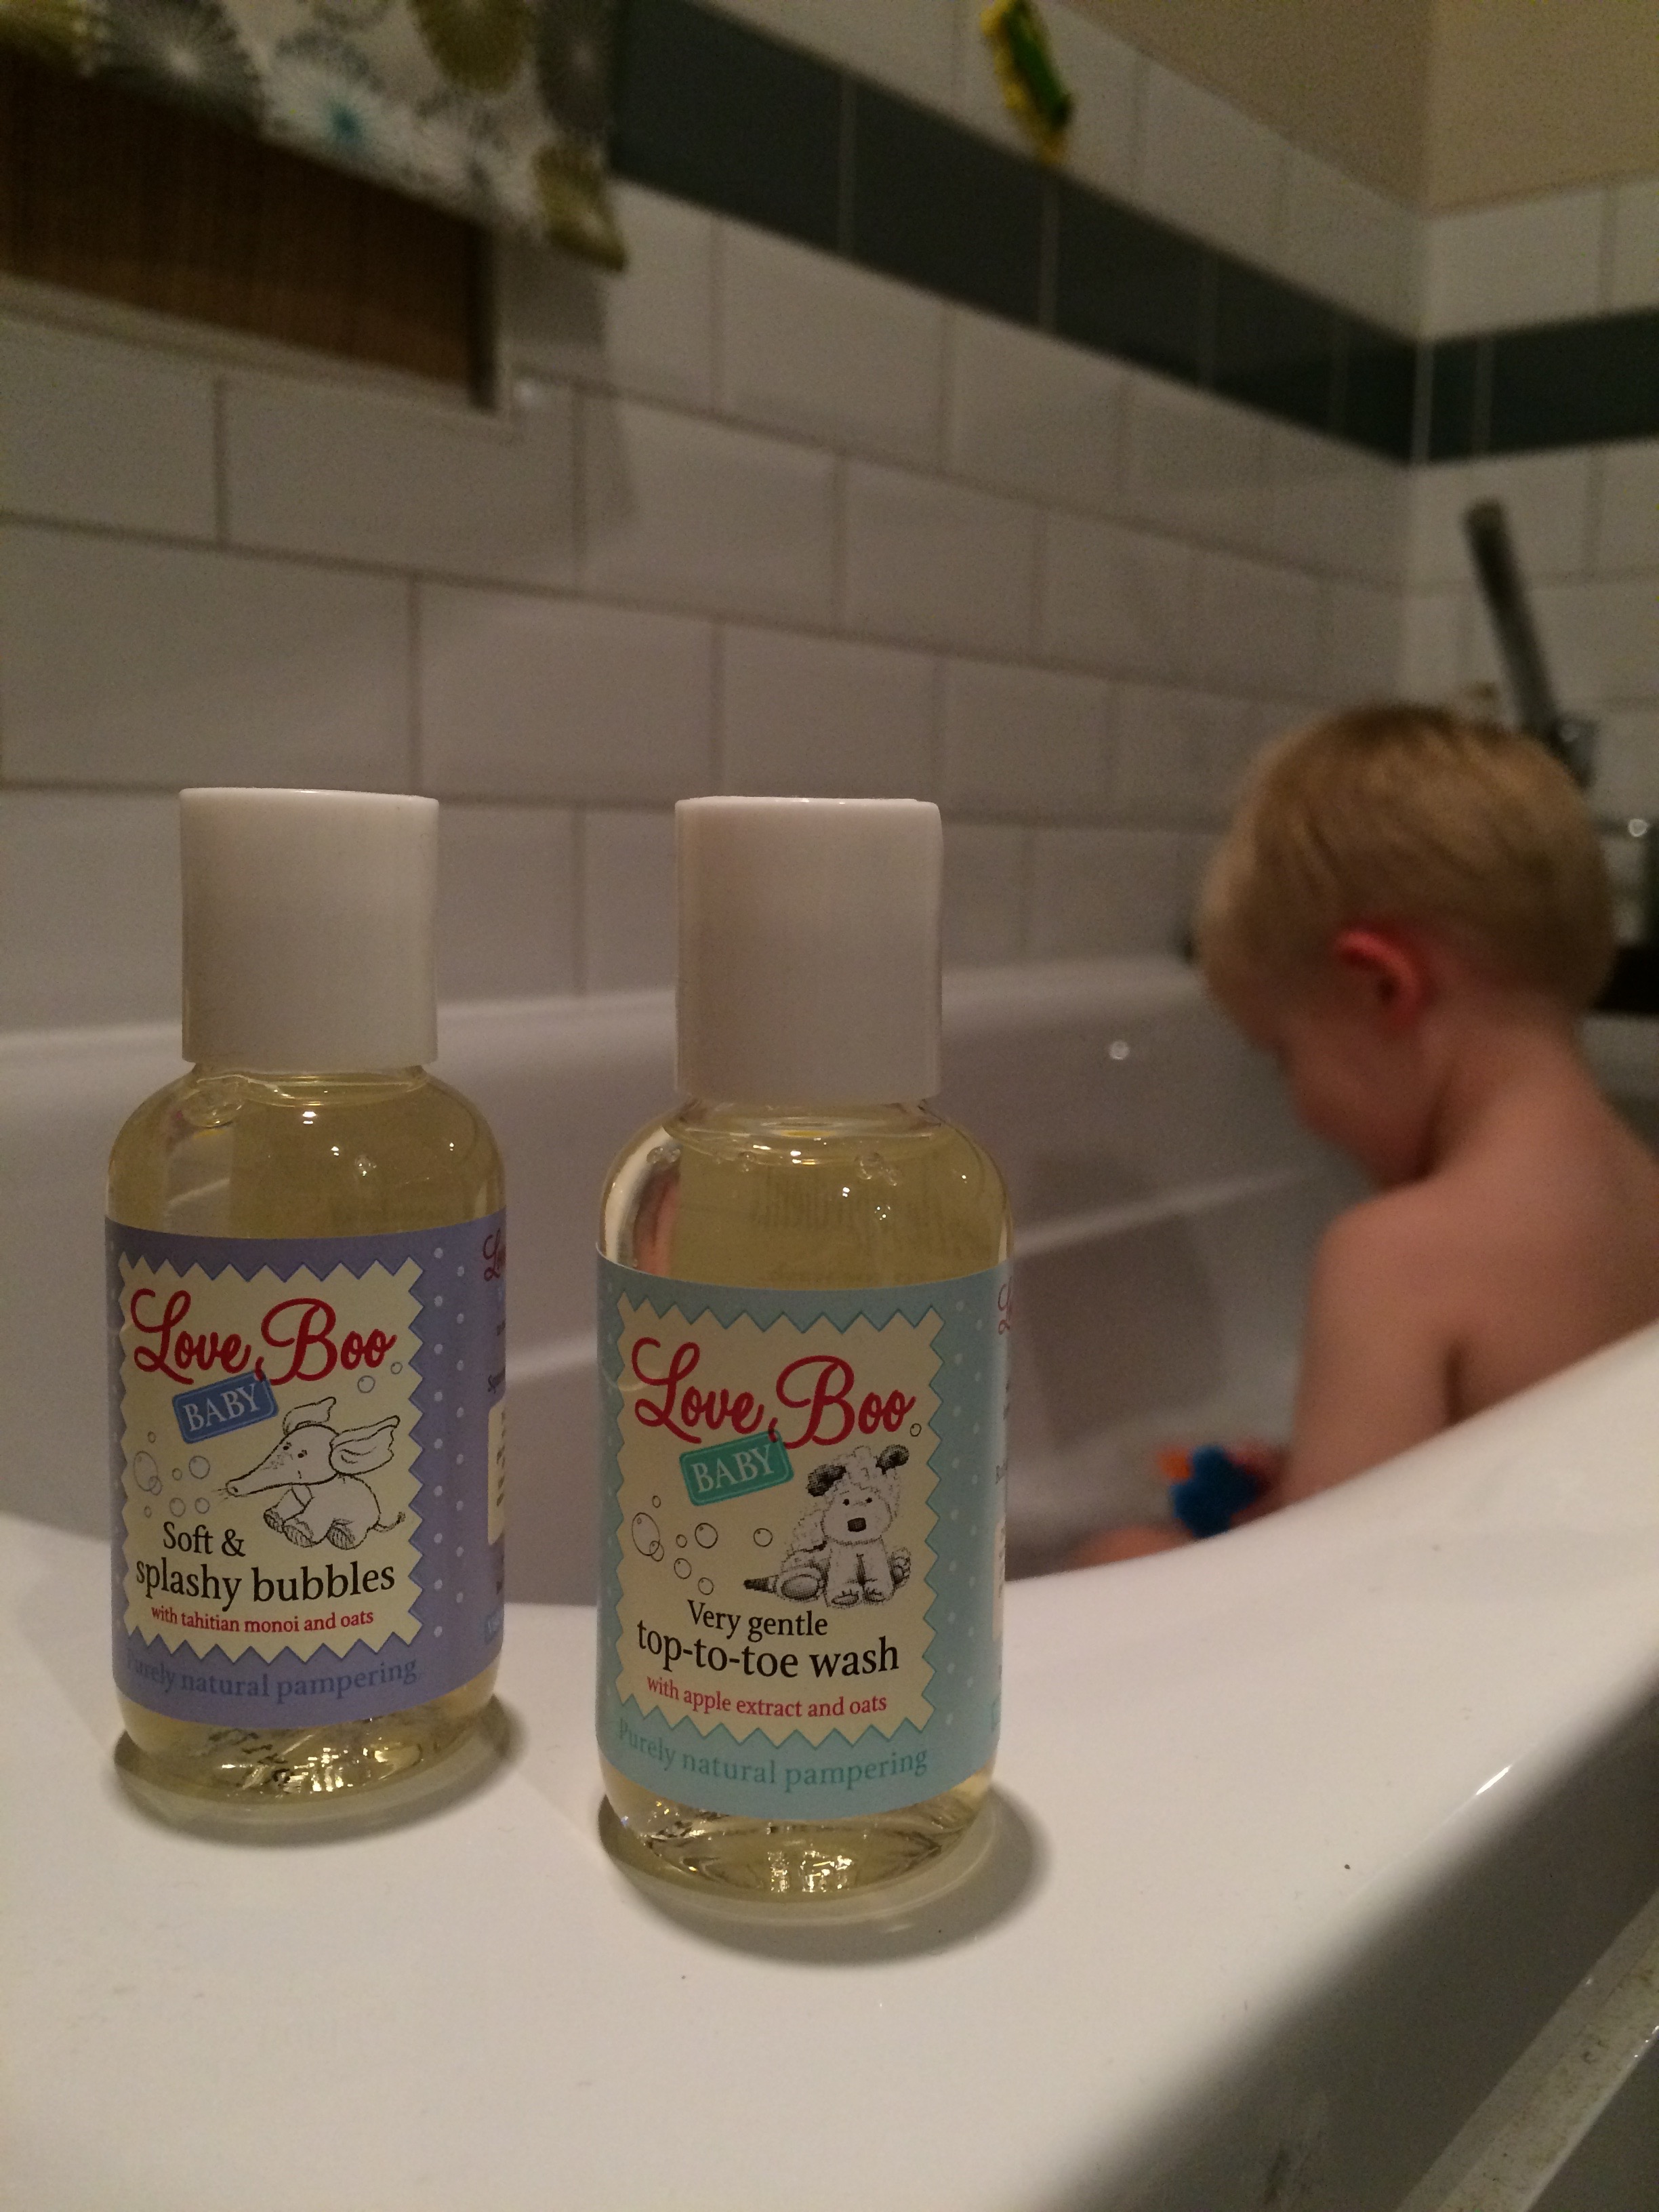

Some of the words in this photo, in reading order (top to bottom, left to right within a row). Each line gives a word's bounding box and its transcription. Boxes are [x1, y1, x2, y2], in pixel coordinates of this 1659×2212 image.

[130, 1288, 253, 1385] Love
[255, 1298, 396, 1387] Boo
[184, 1383, 259, 1432] BABY
[632, 1337, 764, 1443] Love
[766, 1355, 916, 1449] Boo
[690, 1443, 775, 1494] BABY
[163, 1521, 213, 1555] Soft
[221, 1530, 245, 1556] &
[136, 1557, 242, 1611] splashy
[253, 1562, 395, 1602] bubbles
[151, 1603, 178, 1626] with
[180, 1609, 240, 1633] tahitian
[244, 1615, 299, 1633] monoi
[304, 1612, 336, 1631] and
[340, 1609, 374, 1627] oats
[687, 1599, 739, 1637] Very
[749, 1610, 827, 1643] gentle
[637, 1620, 798, 1677] top-to-toe
[811, 1637, 899, 1676] wash
[181, 1674, 269, 1696] natural
[277, 1658, 417, 1704] pampering
[647, 1676, 679, 1700] with
[683, 1687, 731, 1713] apple
[737, 1696, 802, 1717] extract
[808, 1694, 844, 1717] and
[848, 1695, 887, 1715] oats
[618, 1717, 676, 1771] Purely
[682, 1754, 776, 1784] natural
[785, 1749, 927, 1793] pampering
